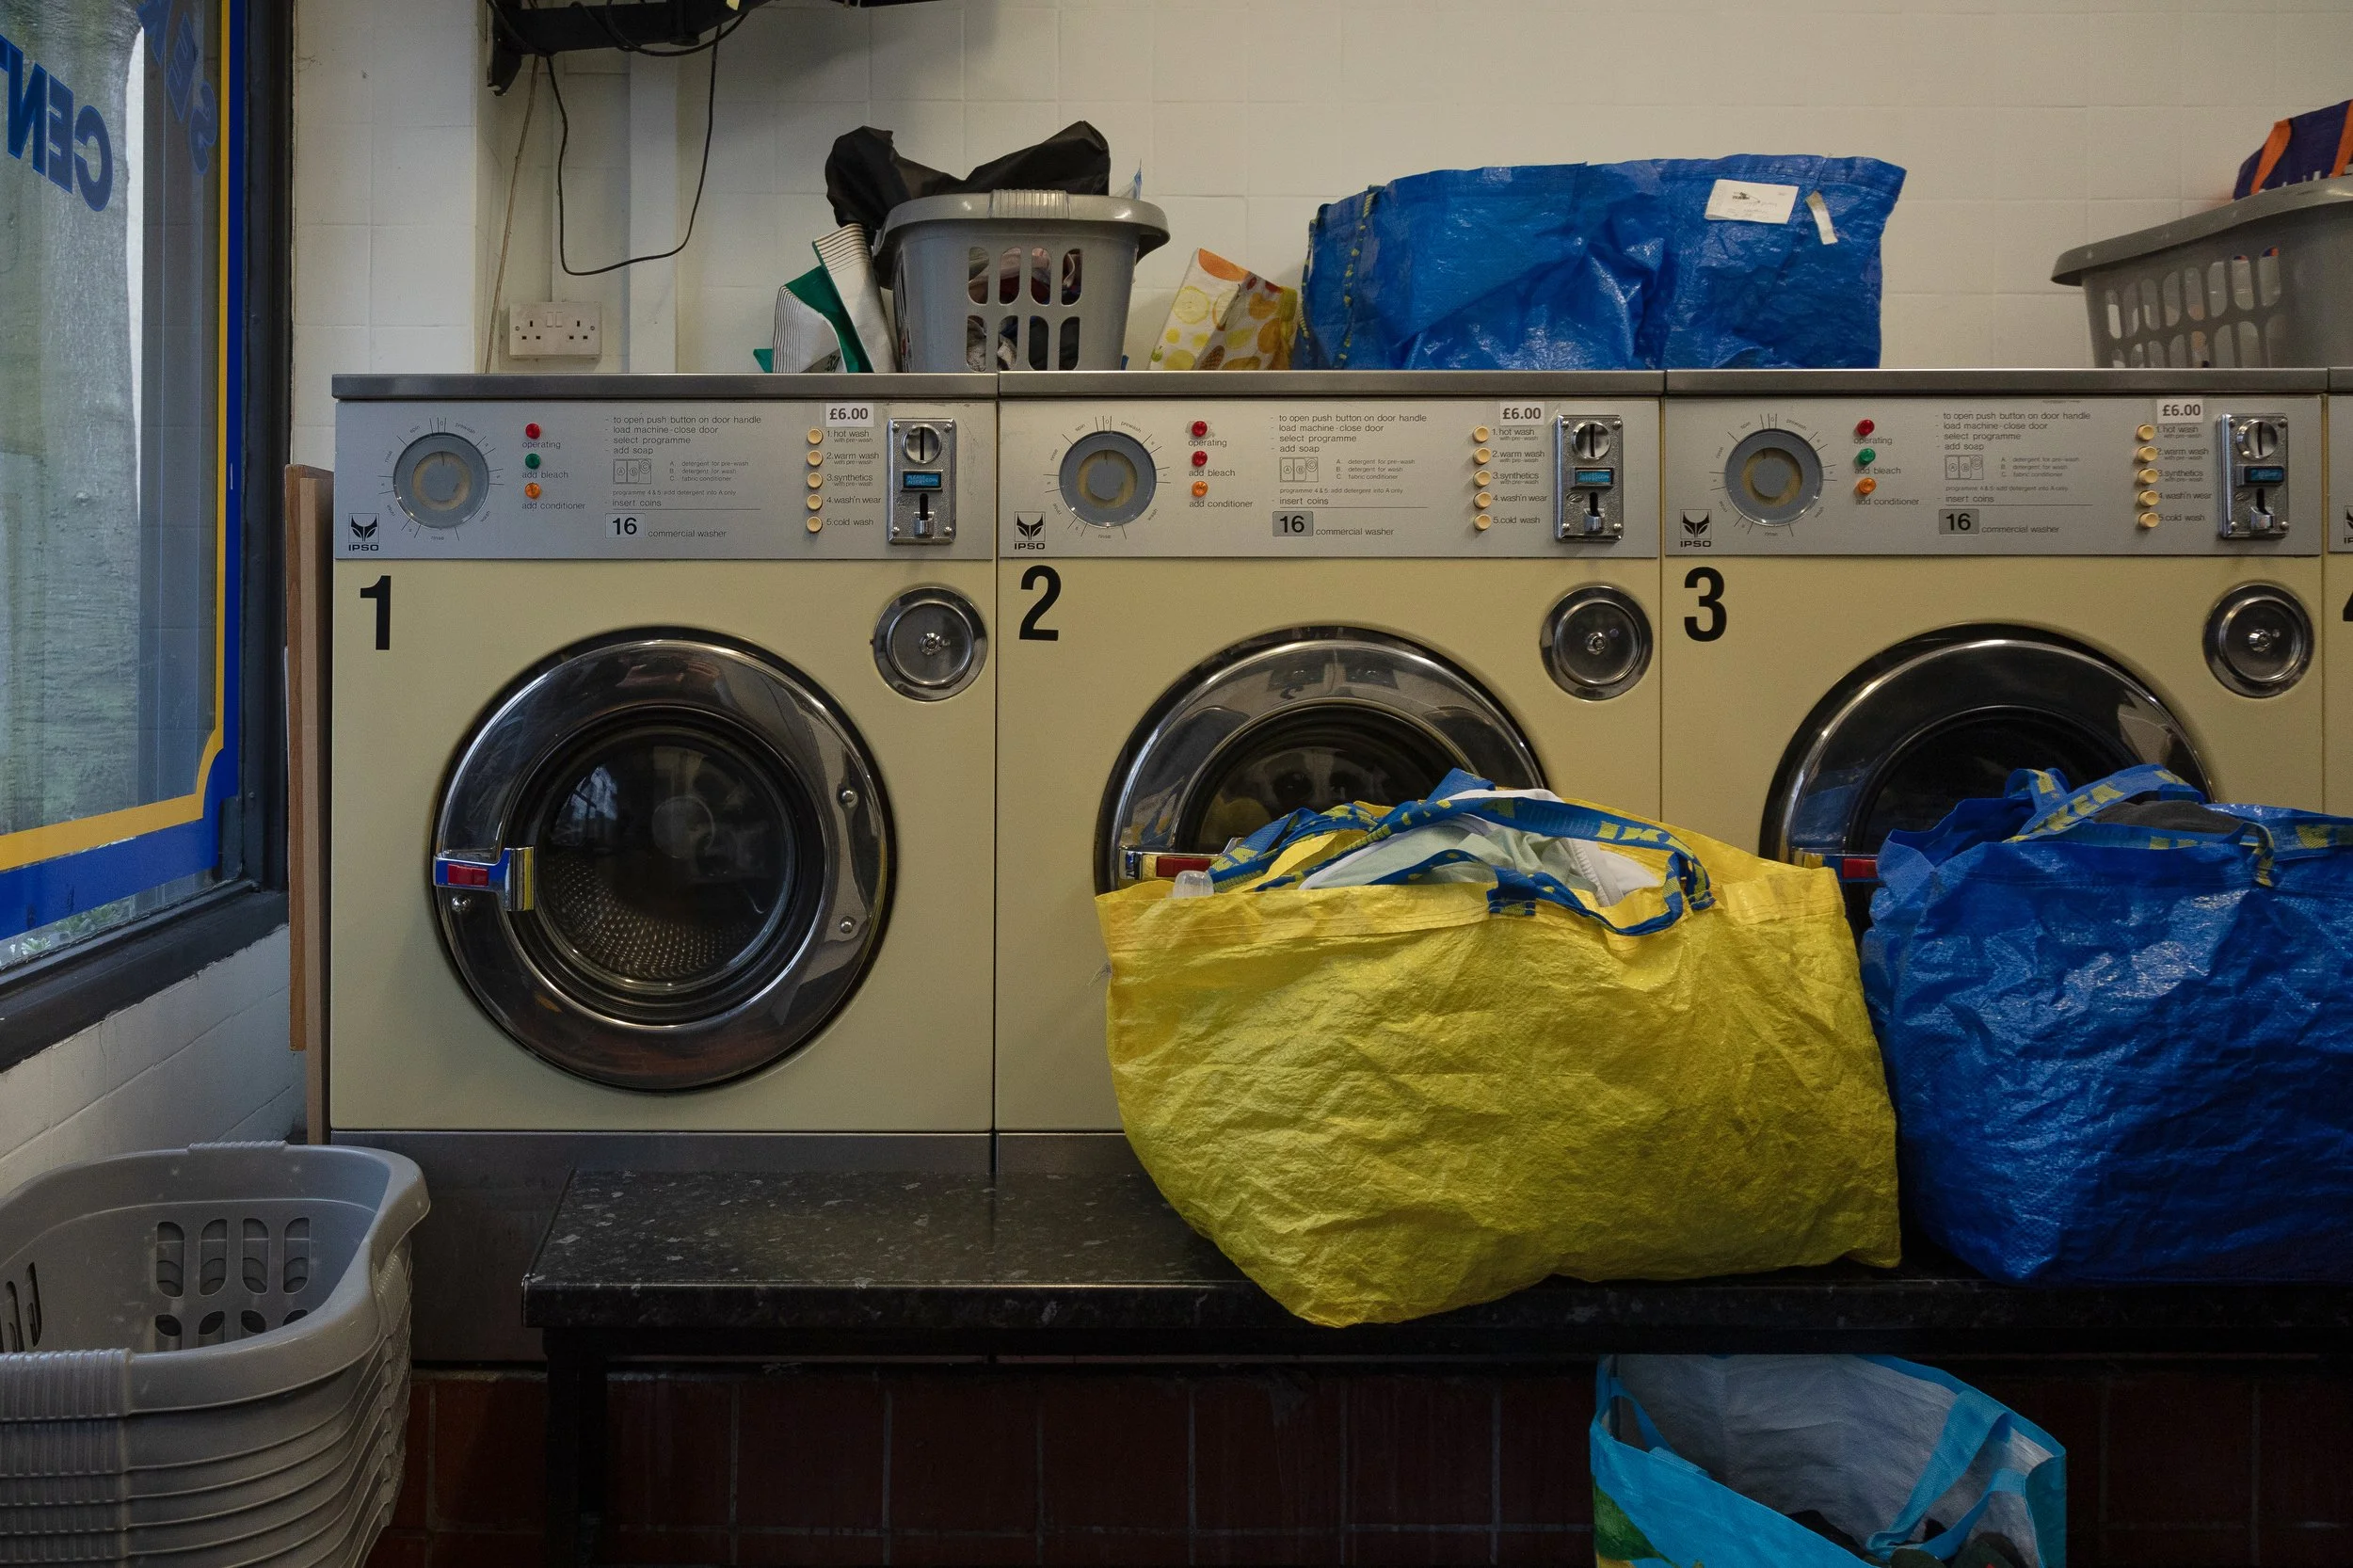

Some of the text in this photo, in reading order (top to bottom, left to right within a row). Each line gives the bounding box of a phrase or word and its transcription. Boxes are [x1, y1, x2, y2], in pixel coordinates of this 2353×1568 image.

[830, 408, 868, 420] £6.00
[1503, 408, 1541, 419] £6.00
[2163, 404, 2201, 416] £6.00
[624, 416, 645, 424] open
[646, 416, 667, 424] push
[712, 416, 731, 424] door
[1289, 414, 1309, 423] open
[1312, 414, 1332, 423] push
[1954, 411, 1974, 421] open
[1977, 412, 1996, 421] push
[2041, 412, 2059, 421] door
[2063, 412, 2090, 421] handle
[613, 425, 631, 434] load
[673, 425, 696, 434] close
[699, 425, 718, 434] door
[1944, 422, 1961, 430] load
[1963, 422, 1999, 430] machine
[2178, 425, 2199, 434] wash
[849, 430, 869, 439] wash
[1513, 427, 1534, 437] wash
[1943, 432, 1969, 441] select
[614, 437, 638, 445] select
[1189, 438, 1226, 448] operating
[1280, 435, 1304, 444] select
[1854, 436, 1892, 445] operating
[521, 440, 562, 449] operating
[1963, 442, 1984, 451] soap
[614, 446, 653, 456] add soap
[858, 452, 879, 460] wash
[521, 470, 568, 479] add bleach
[1854, 466, 1869, 474] add
[613, 499, 662, 507] insert coins
[1190, 499, 1204, 507] add
[1280, 497, 1328, 505] insert coins
[1873, 497, 1919, 505] conditioner
[1945, 495, 1994, 504] insert coins
[522, 501, 585, 510] add conditioner
[613, 518, 637, 535] 16
[1280, 516, 1305, 533] 16
[1946, 513, 1971, 531] 16
[648, 529, 696, 538] commercial
[1981, 525, 2028, 534] commercial
[1019, 565, 1061, 641] 2
[1684, 567, 1727, 642] 3
[360, 575, 392, 650] 1
